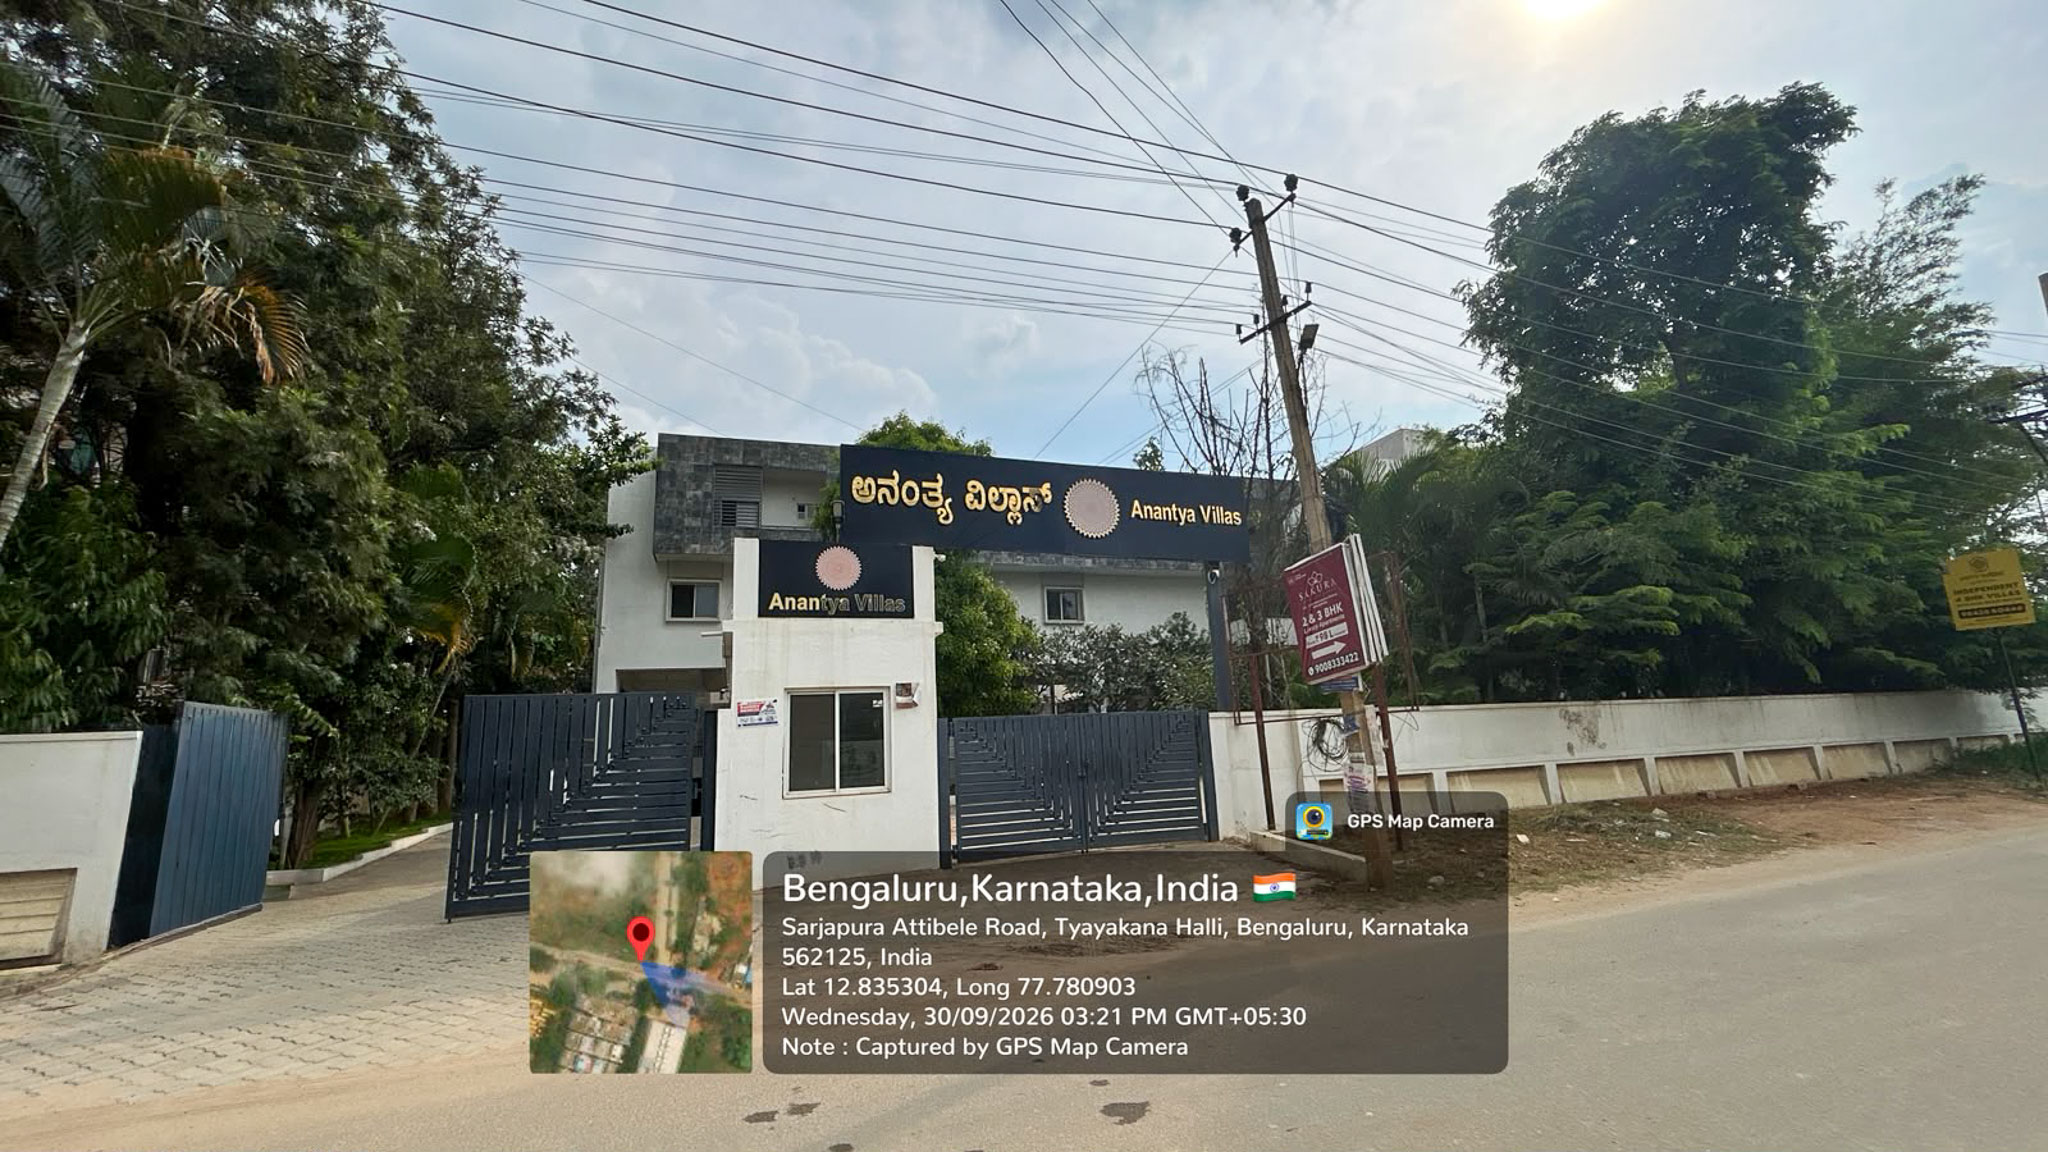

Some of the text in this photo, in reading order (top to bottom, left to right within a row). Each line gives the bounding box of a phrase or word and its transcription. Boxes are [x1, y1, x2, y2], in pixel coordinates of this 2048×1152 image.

[851, 469, 1053, 525] ಅನಂತ್ಯ ವಿಲ್ಲಾಸ್
[1131, 499, 1242, 526] Anantya Villas
[768, 592, 906, 616] Anantya Villas
[1302, 616, 1308, 627] 2
[1308, 613, 1316, 624] &
[1316, 610, 1323, 621] 3
[1323, 601, 1343, 618] BHK
